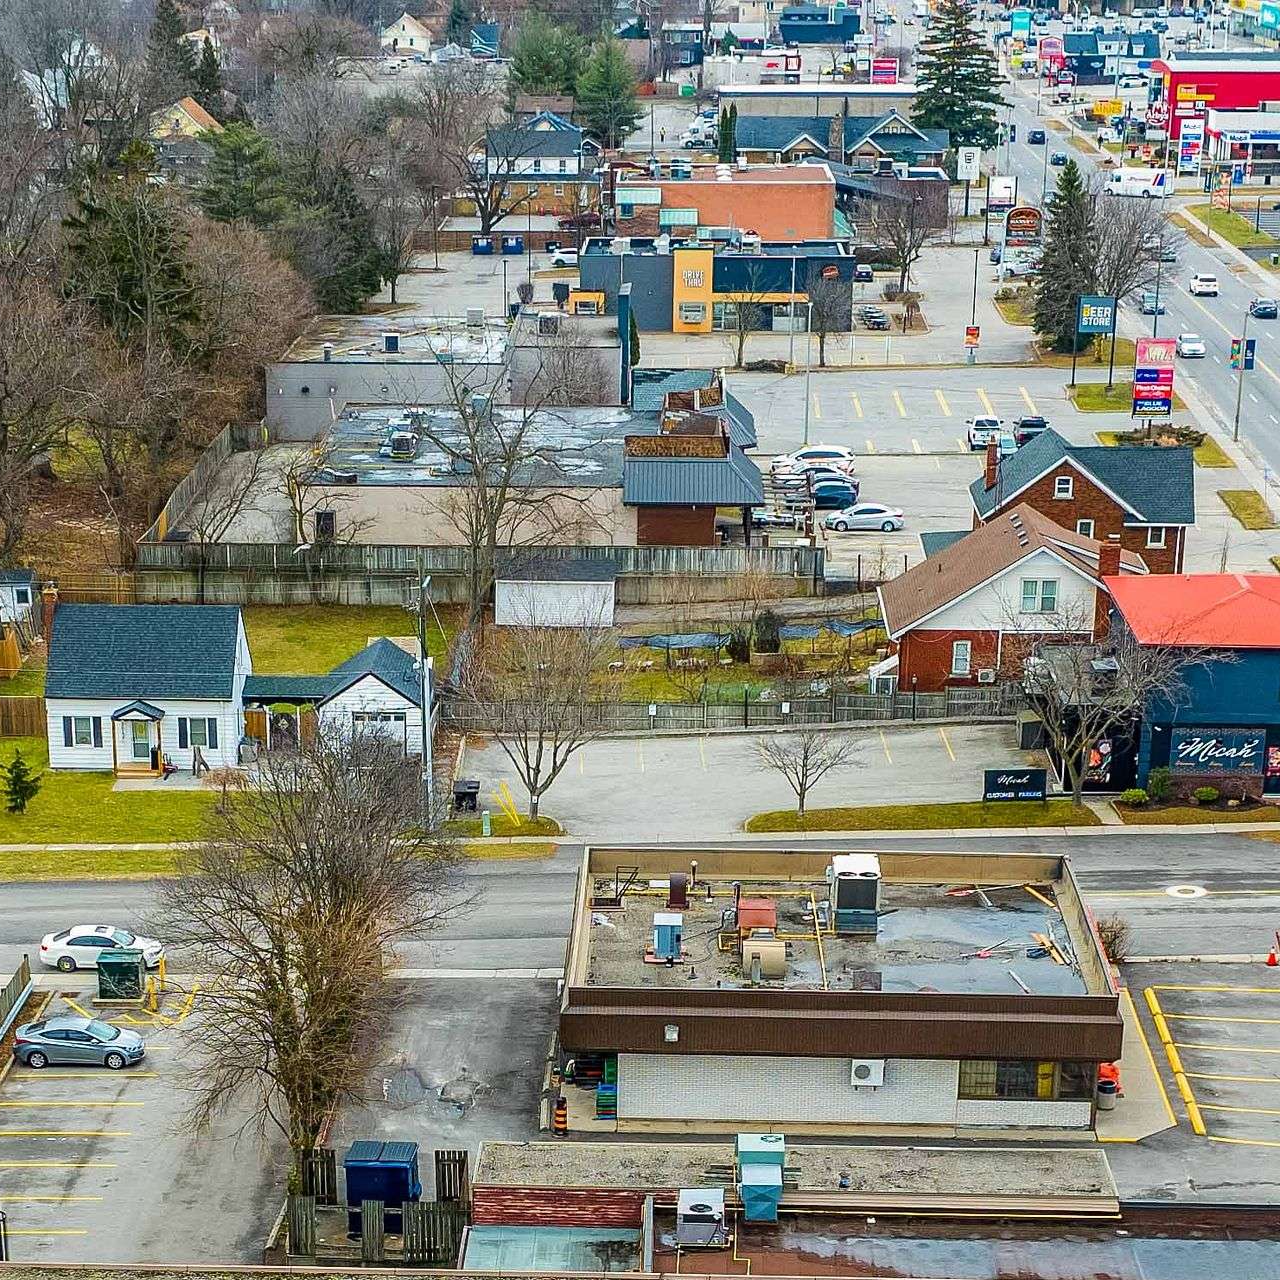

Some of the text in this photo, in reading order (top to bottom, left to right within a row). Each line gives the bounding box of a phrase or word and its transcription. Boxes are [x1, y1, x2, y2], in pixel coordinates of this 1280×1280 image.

[683, 270, 705, 279] DRIVE
[684, 278, 704, 287] THRU
[1083, 306, 1112, 317] BEER
[1082, 317, 1111, 326] STORE
[1177, 737, 1261, 762] Micah
